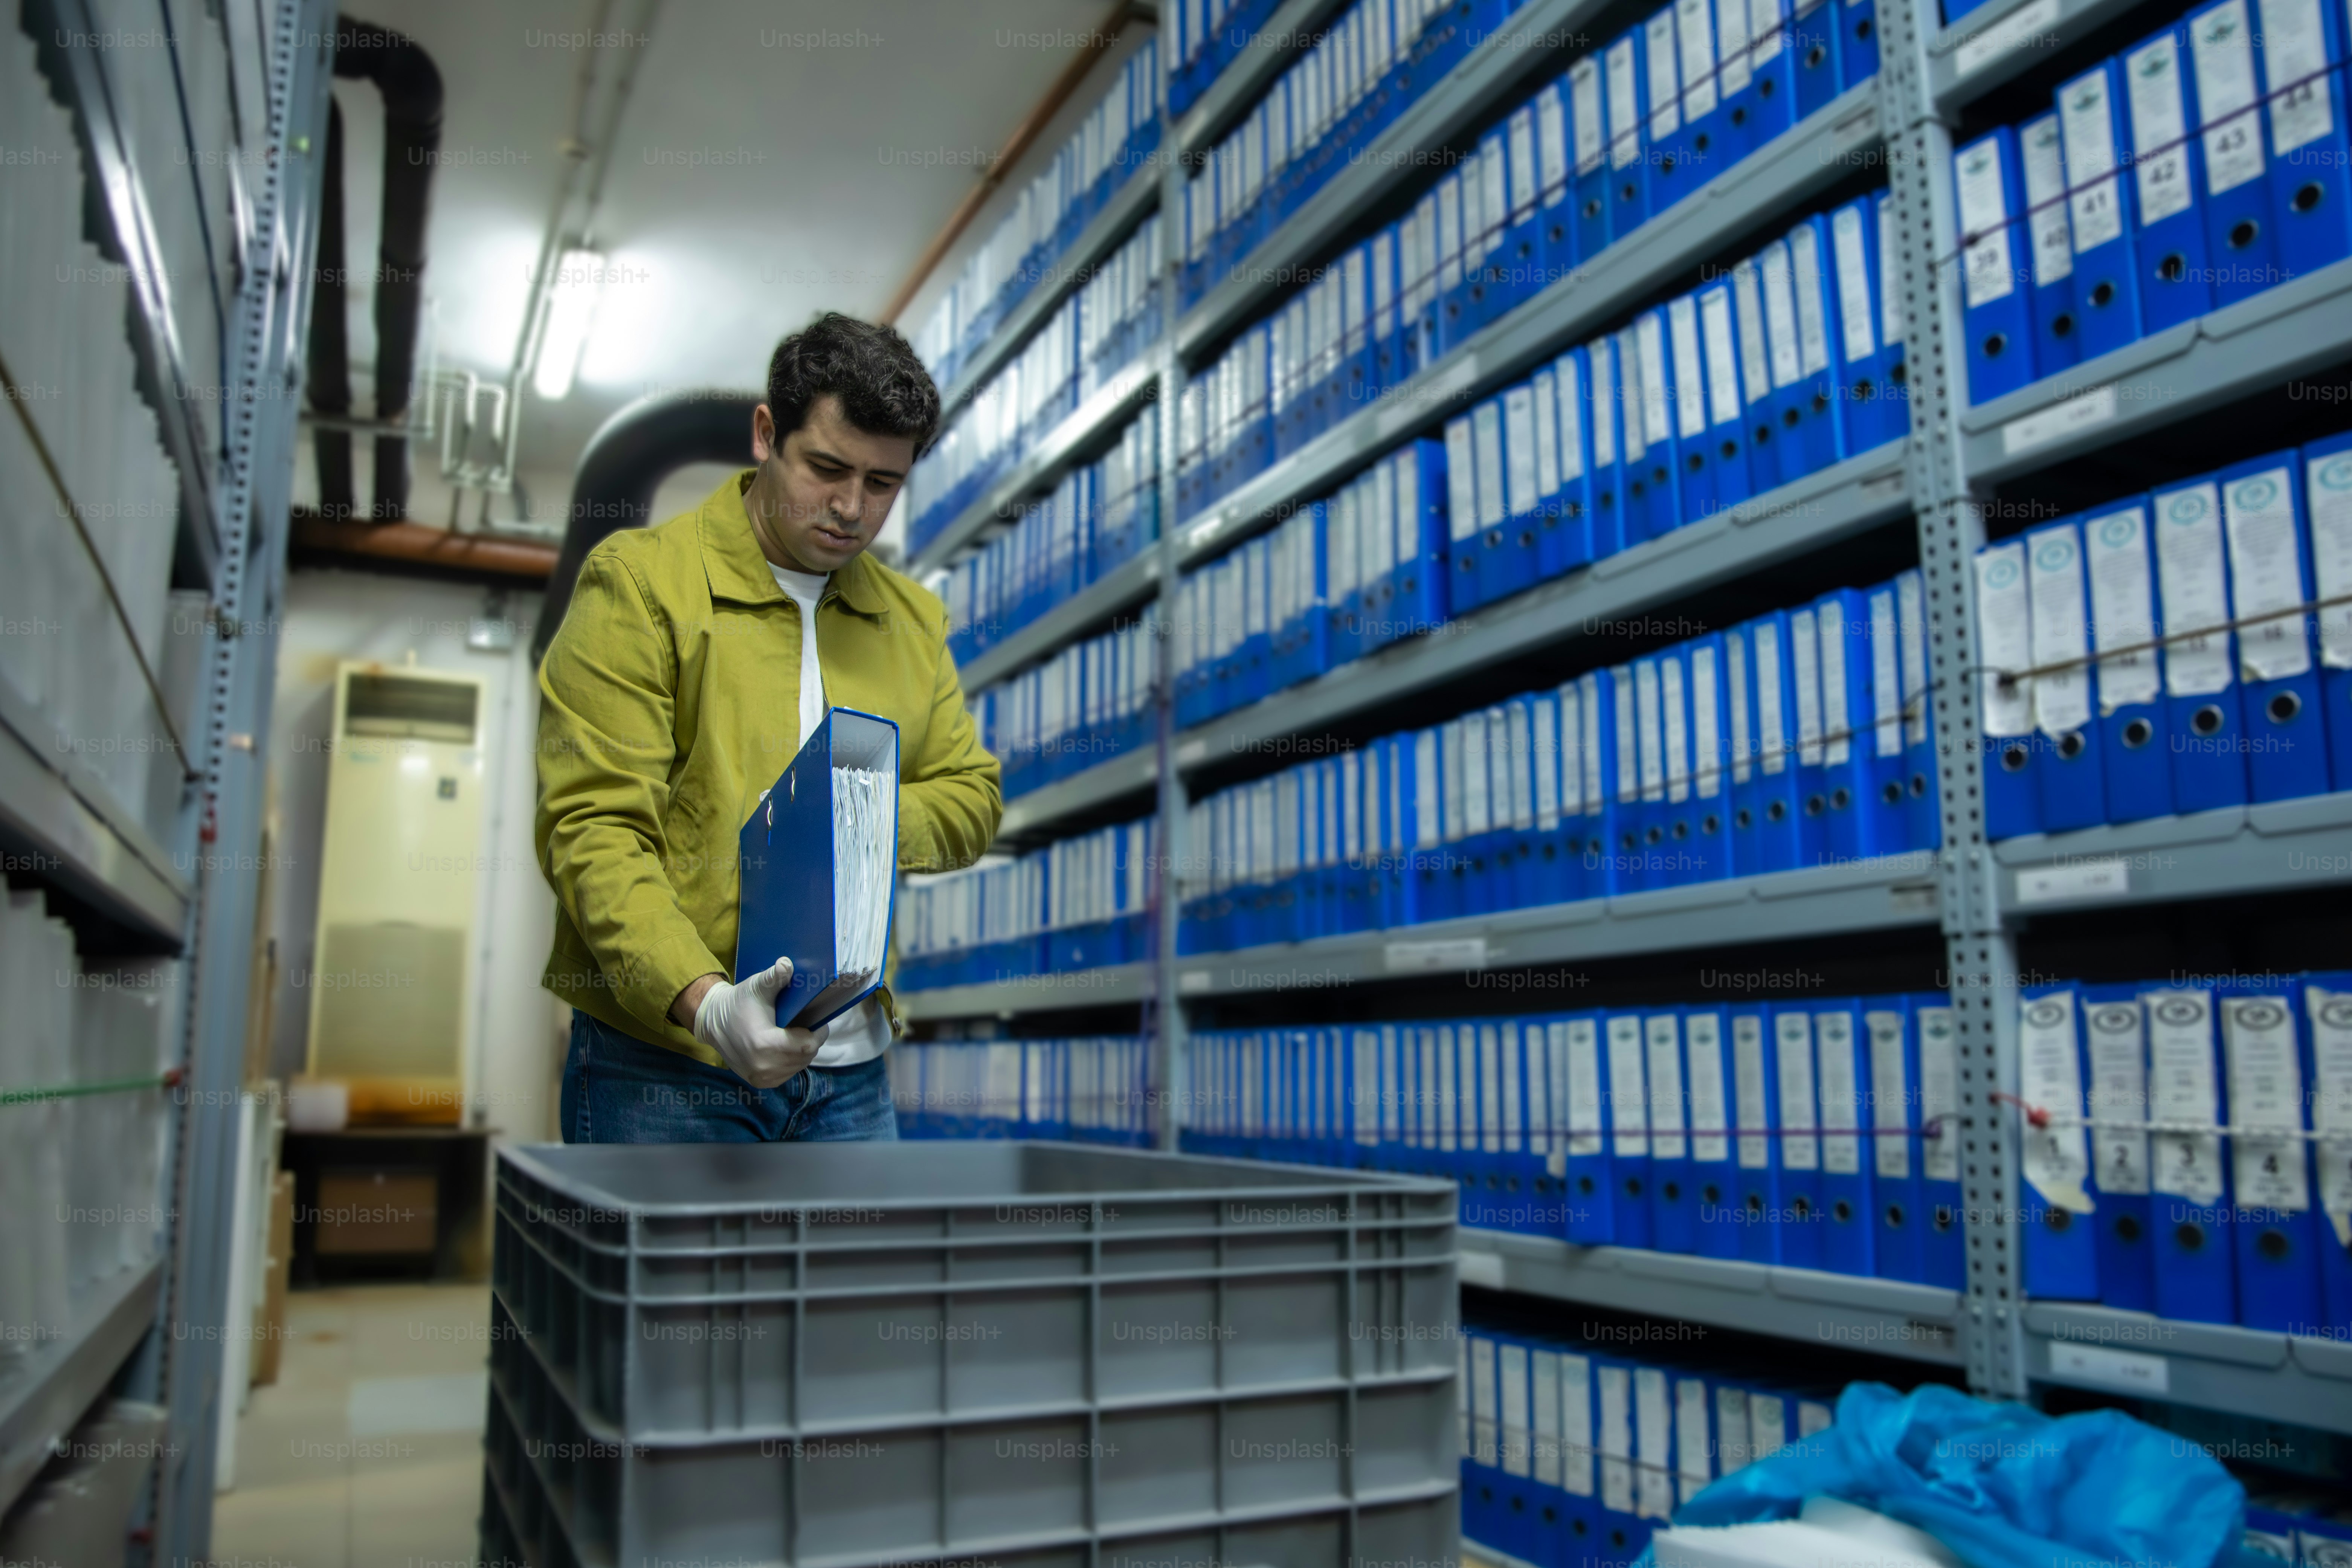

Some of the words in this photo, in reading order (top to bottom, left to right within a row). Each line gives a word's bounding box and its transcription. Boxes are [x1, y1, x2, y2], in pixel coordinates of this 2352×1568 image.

[2216, 127, 2246, 154] 43
[2150, 161, 2176, 185] 42
[2084, 192, 2106, 214] 41
[2049, 1136, 2059, 1155] 1
[2114, 1145, 2129, 1167] 2
[2179, 1143, 2195, 1167] 3
[2262, 1153, 2279, 1174] 4
